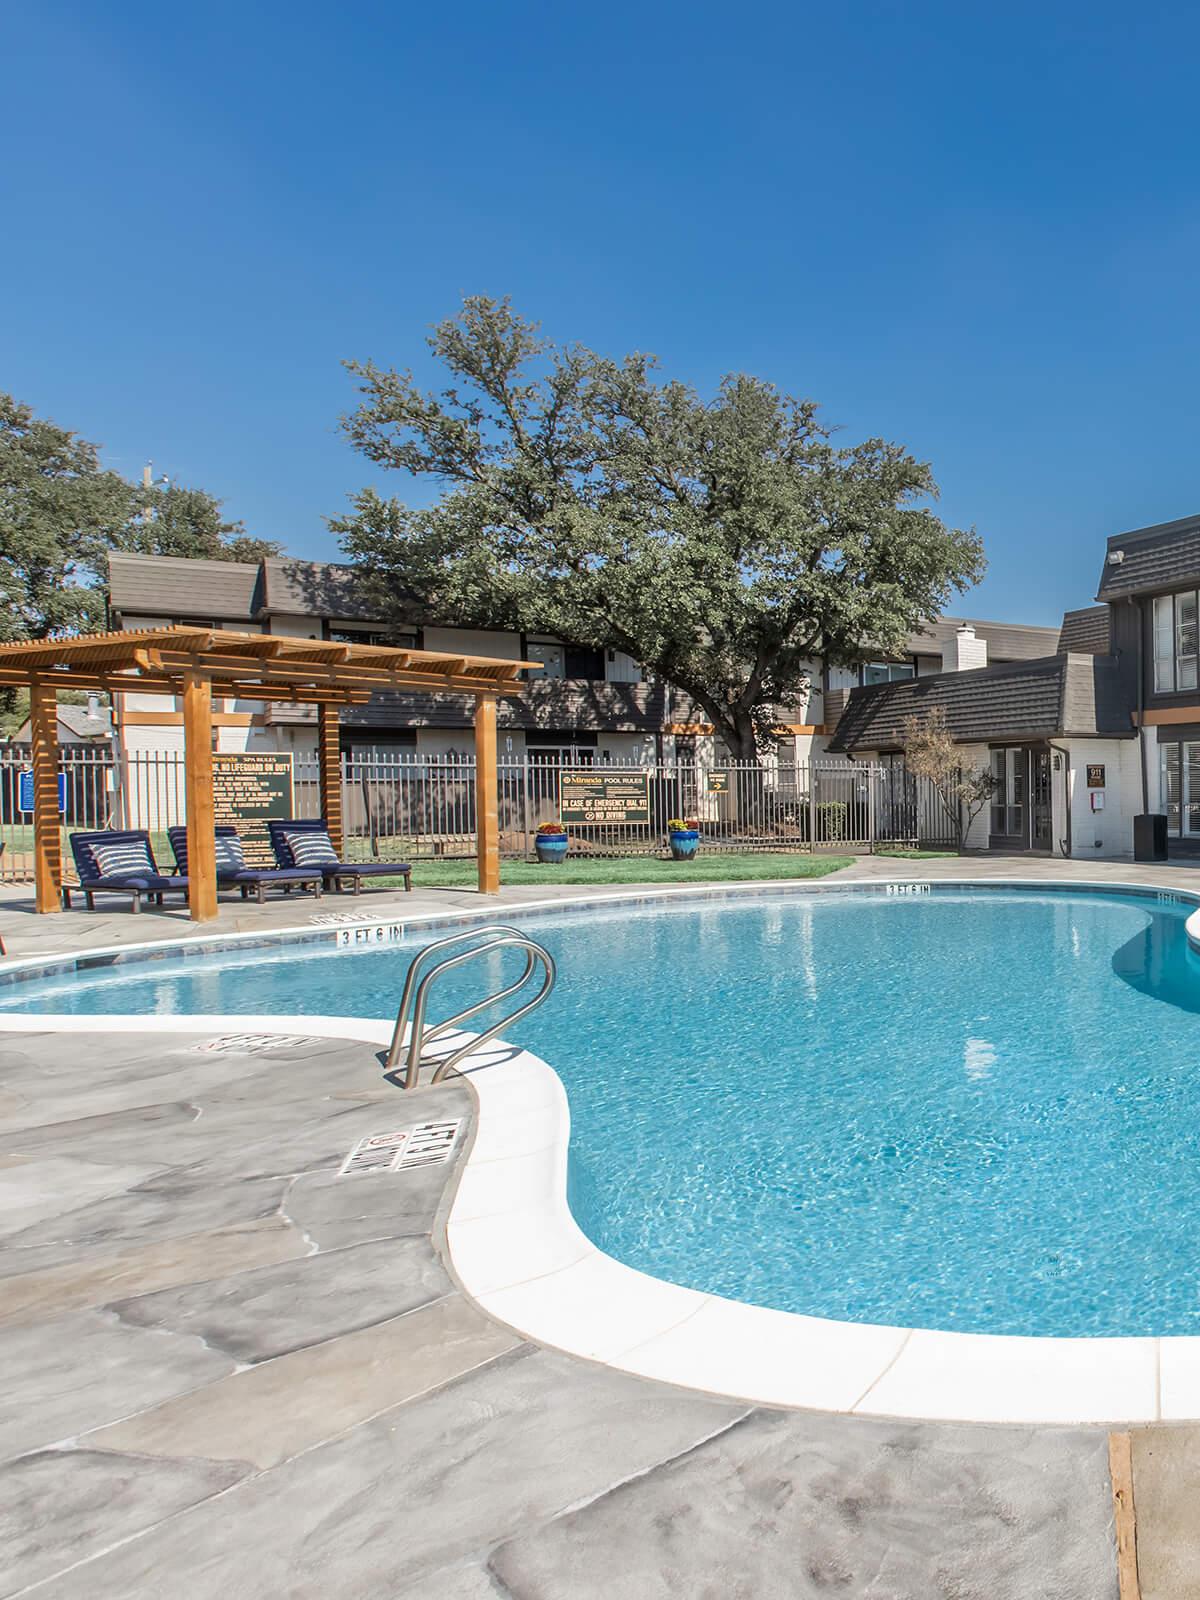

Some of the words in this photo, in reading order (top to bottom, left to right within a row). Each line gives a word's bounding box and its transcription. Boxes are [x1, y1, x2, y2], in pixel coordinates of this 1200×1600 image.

[231, 763, 263, 772] LIFEGUARD
[275, 763, 290, 772] DUTY
[562, 799, 569, 807] IN
[570, 799, 584, 807] CASE
[585, 799, 593, 807] OF
[594, 799, 625, 807] EMERGENCY
[626, 799, 638, 807] DIAL
[639, 799, 647, 807] 911
[595, 811, 605, 820] NO
[606, 811, 626, 820] DIVING
[342, 931, 350, 945] 3
[355, 928, 371, 944] FT
[376, 927, 384, 941] 6
[389, 925, 402, 940] IN
